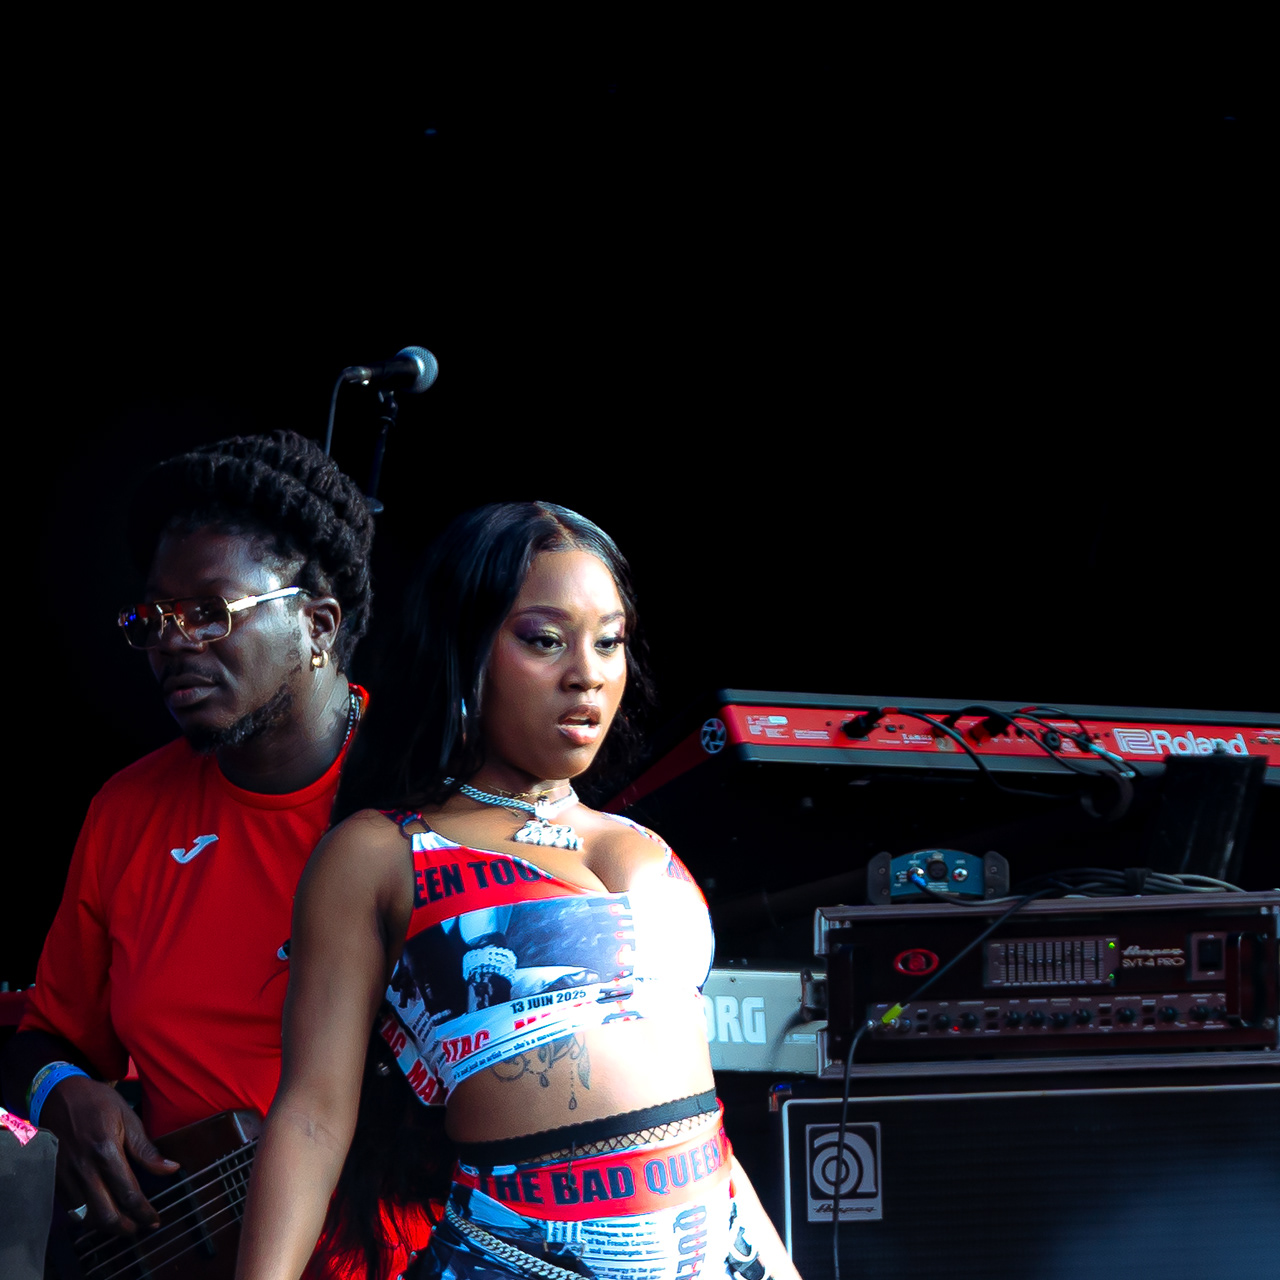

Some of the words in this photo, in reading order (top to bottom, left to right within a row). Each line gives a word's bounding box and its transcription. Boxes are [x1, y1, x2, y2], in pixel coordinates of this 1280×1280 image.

[1151, 728, 1248, 756] Roland
[1157, 956, 1186, 967] PRO
[511, 1001, 524, 1014] 13
[528, 995, 553, 1011] JUIN
[557, 989, 587, 1004] 2025
[479, 1169, 544, 1205] THE
[550, 1165, 636, 1206] BAD
